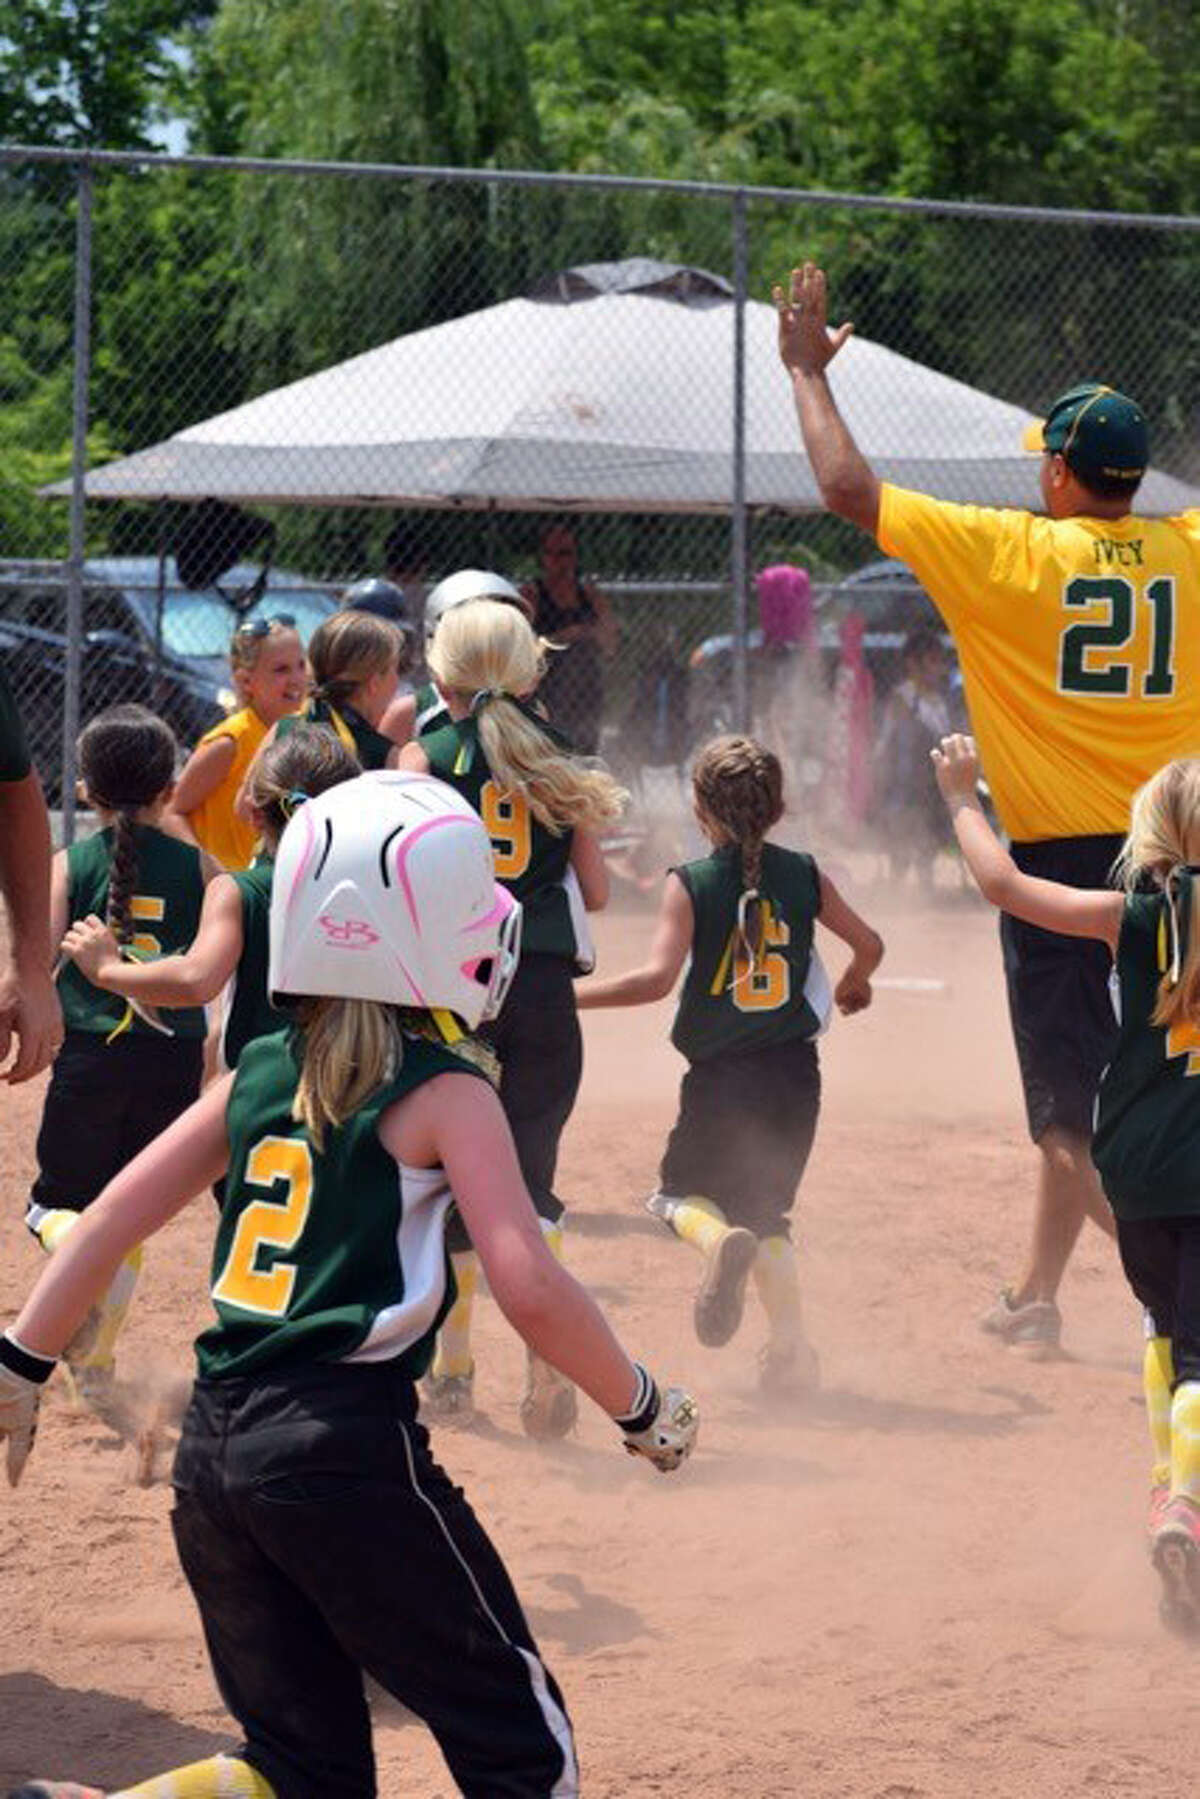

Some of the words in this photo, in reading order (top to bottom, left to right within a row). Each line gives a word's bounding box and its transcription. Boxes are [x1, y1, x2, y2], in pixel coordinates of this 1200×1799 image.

[1093, 539, 1144, 566] IVEY
[1058, 575, 1176, 698] 21
[480, 780, 532, 879] 9
[732, 917, 790, 1012] 6
[211, 1135, 314, 1318] 2
